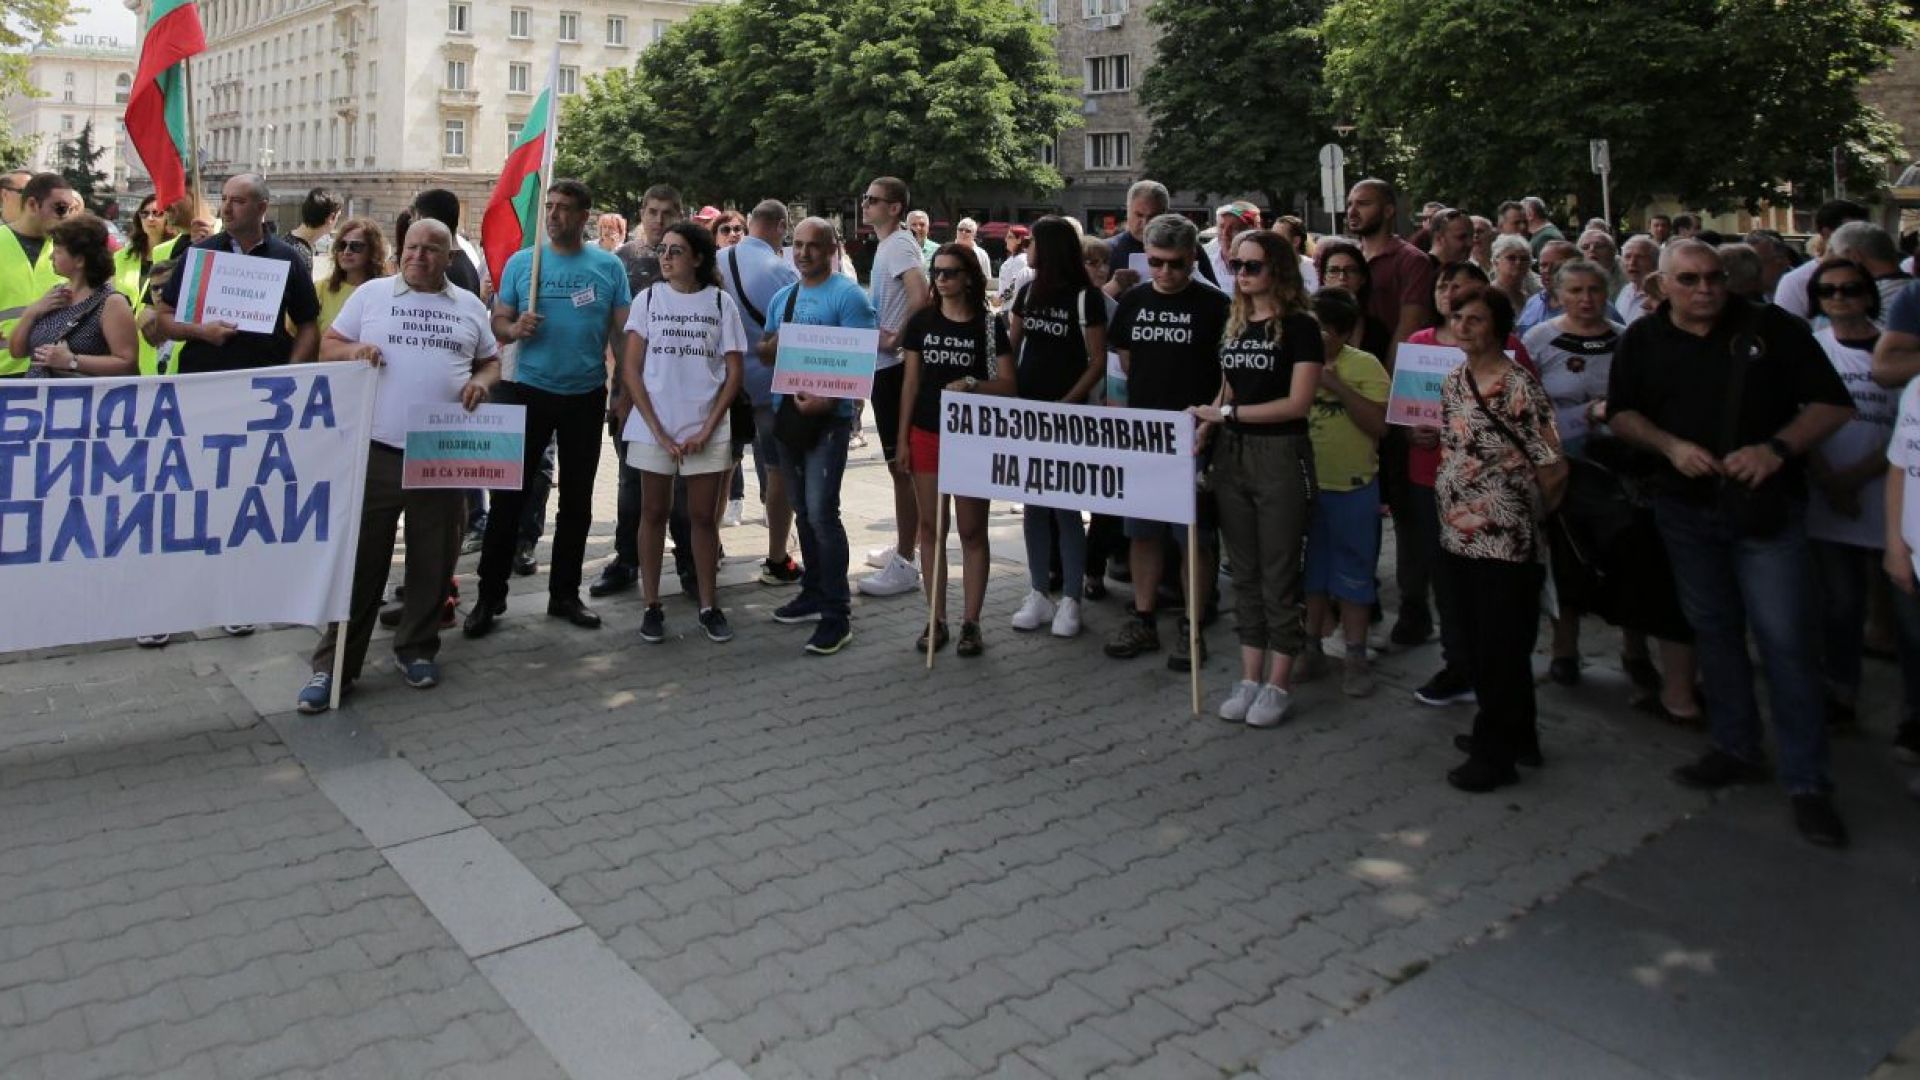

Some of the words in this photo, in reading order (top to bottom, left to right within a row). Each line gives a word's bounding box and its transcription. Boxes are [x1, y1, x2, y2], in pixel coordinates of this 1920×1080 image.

[1136, 308, 1155, 322] Аз
[1159, 311, 1191, 324] съм
[388, 335, 402, 344] не
[406, 336, 418, 346] са
[923, 333, 940, 347] Аз
[943, 337, 975, 349] съм
[1131, 326, 1192, 344] БОРКО!
[664, 346, 676, 355] са
[247, 375, 336, 431] ЗА
[947, 402, 973, 434] ЗА
[978, 406, 1177, 455] ВЪЗОБНОВЯВАНЕ
[440, 467, 453, 478] СА
[991, 453, 1019, 487] НА
[1024, 457, 1124, 499] ДЕЛОТО!
